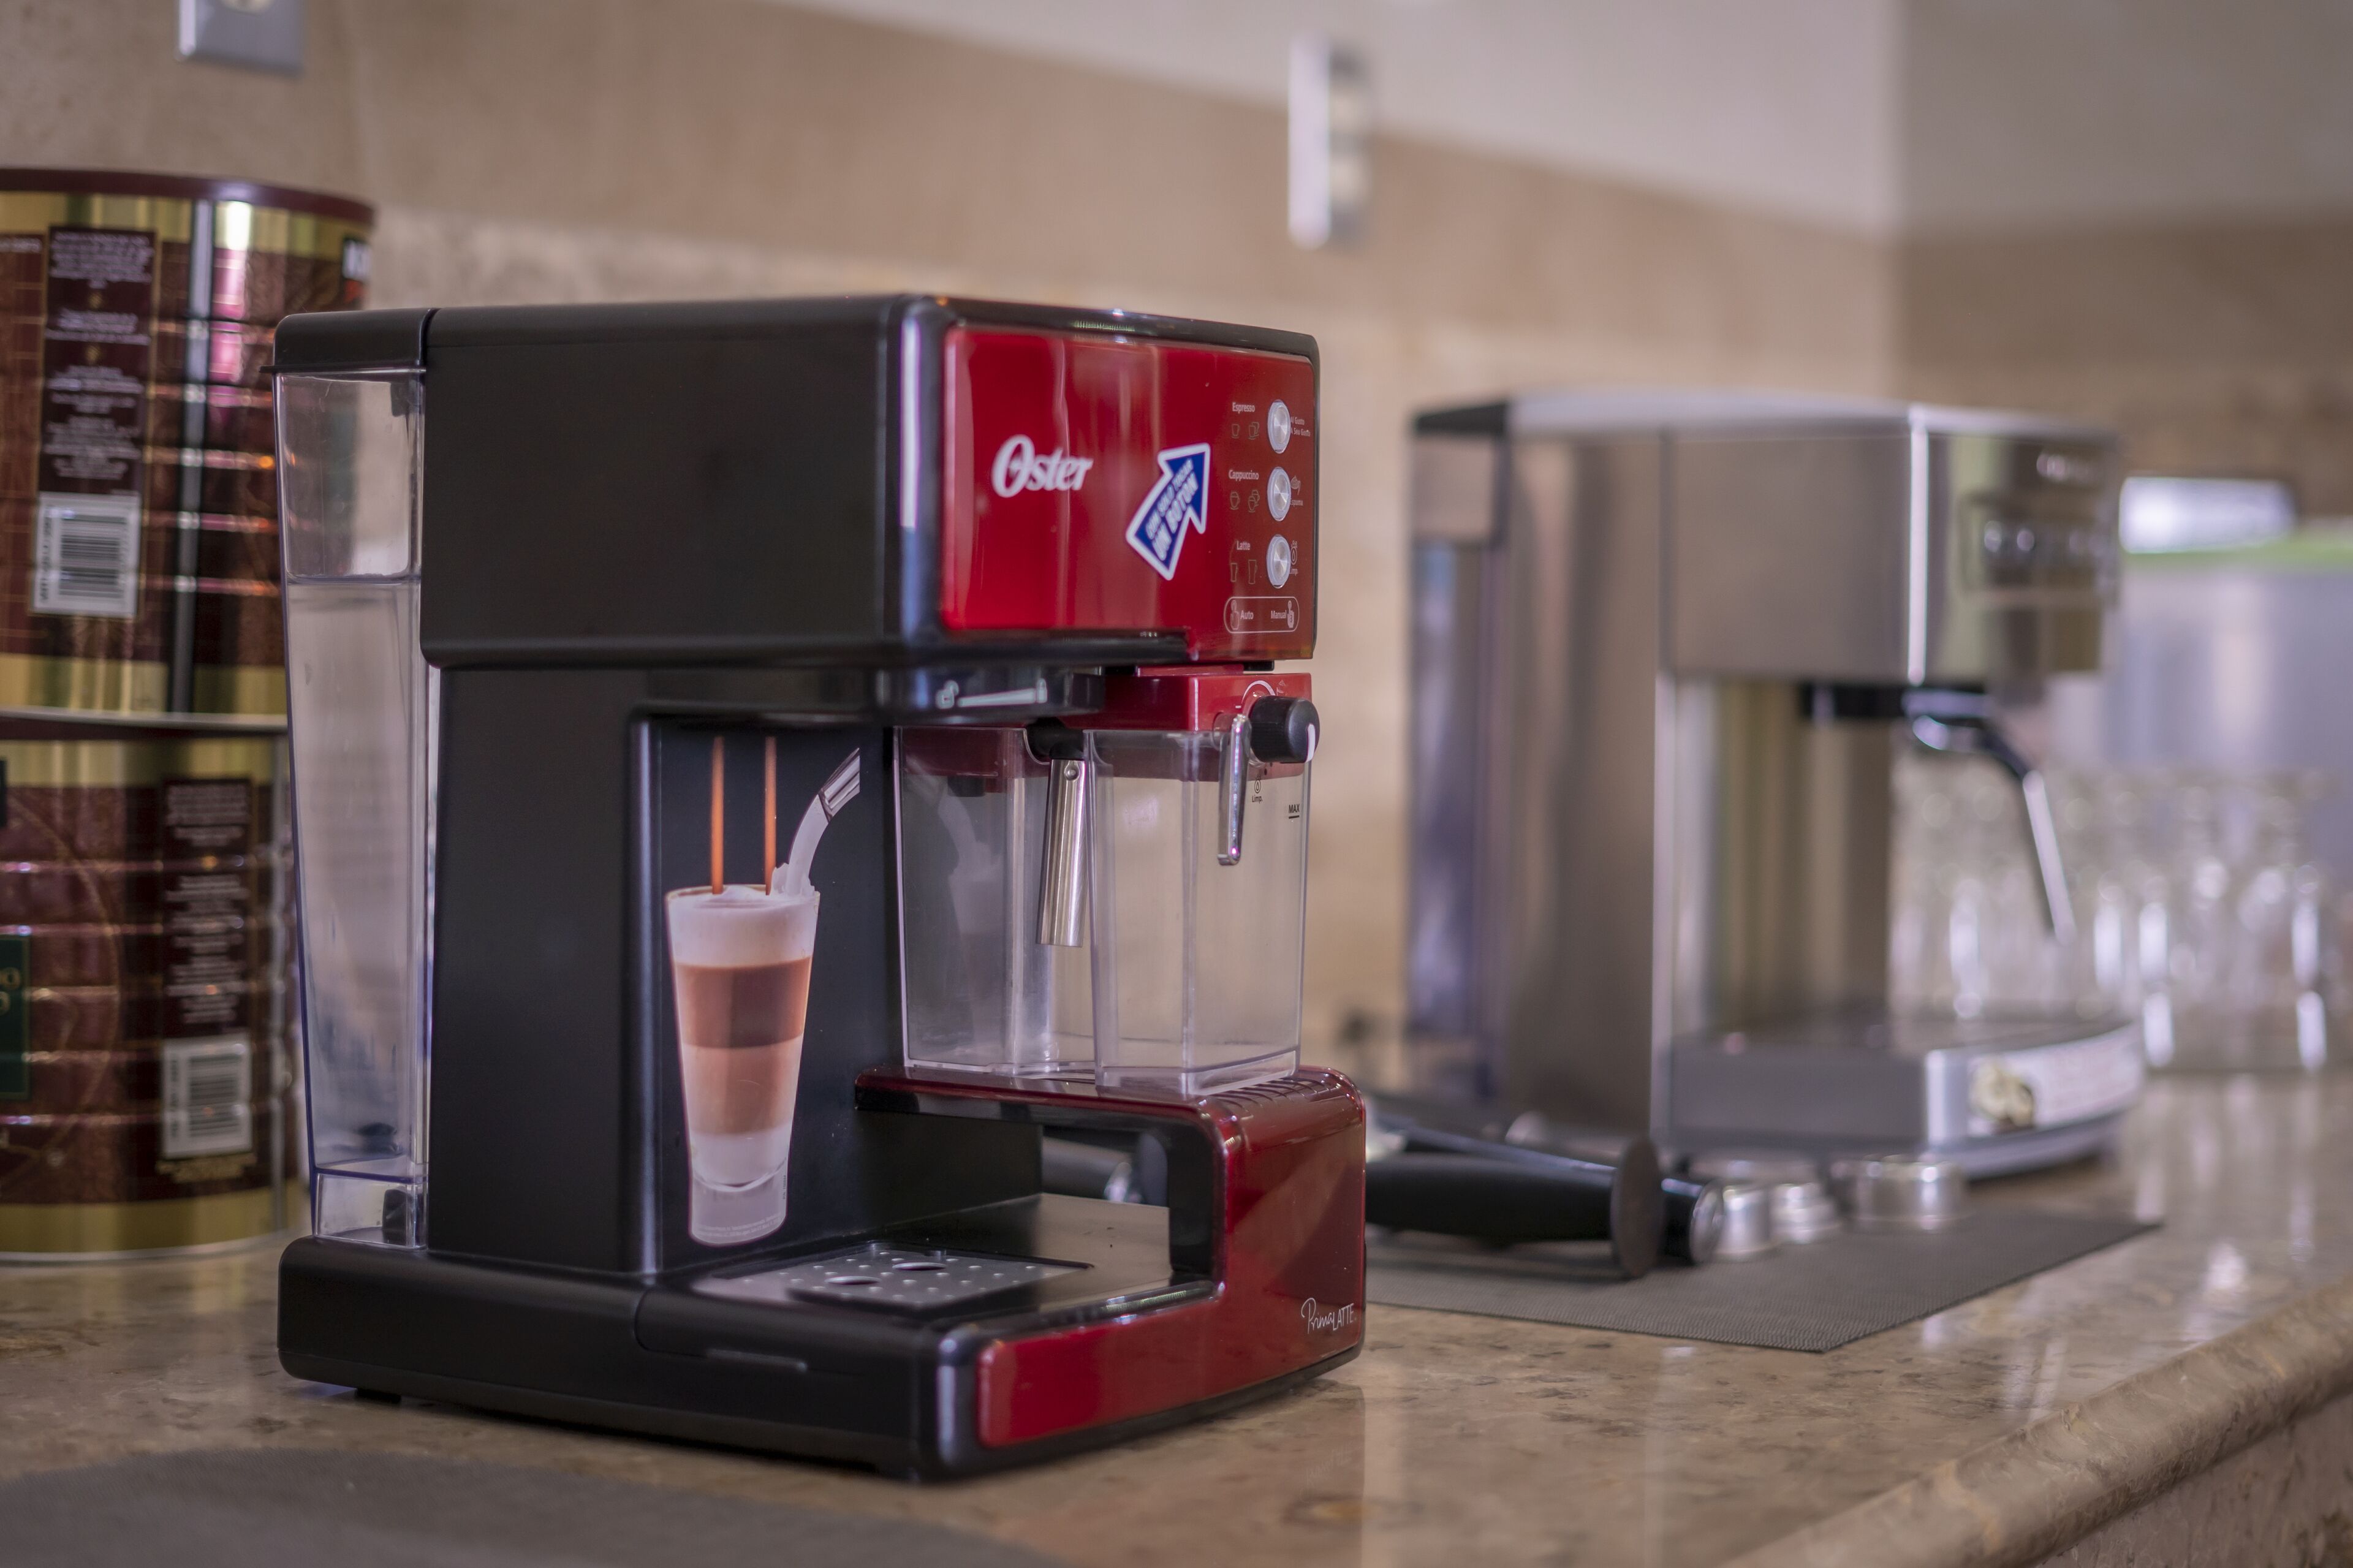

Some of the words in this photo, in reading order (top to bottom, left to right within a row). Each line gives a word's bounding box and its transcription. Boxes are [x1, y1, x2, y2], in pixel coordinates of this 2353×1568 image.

[1232, 402, 1255, 414] Espresso
[991, 434, 1094, 498] Oster
[1229, 469, 1259, 481] Cappuccino
[1237, 540, 1251, 551] Latte
[1240, 610, 1254, 619] Auto
[1271, 610, 1287, 619] Manual
[1289, 804, 1300, 814] MAX
